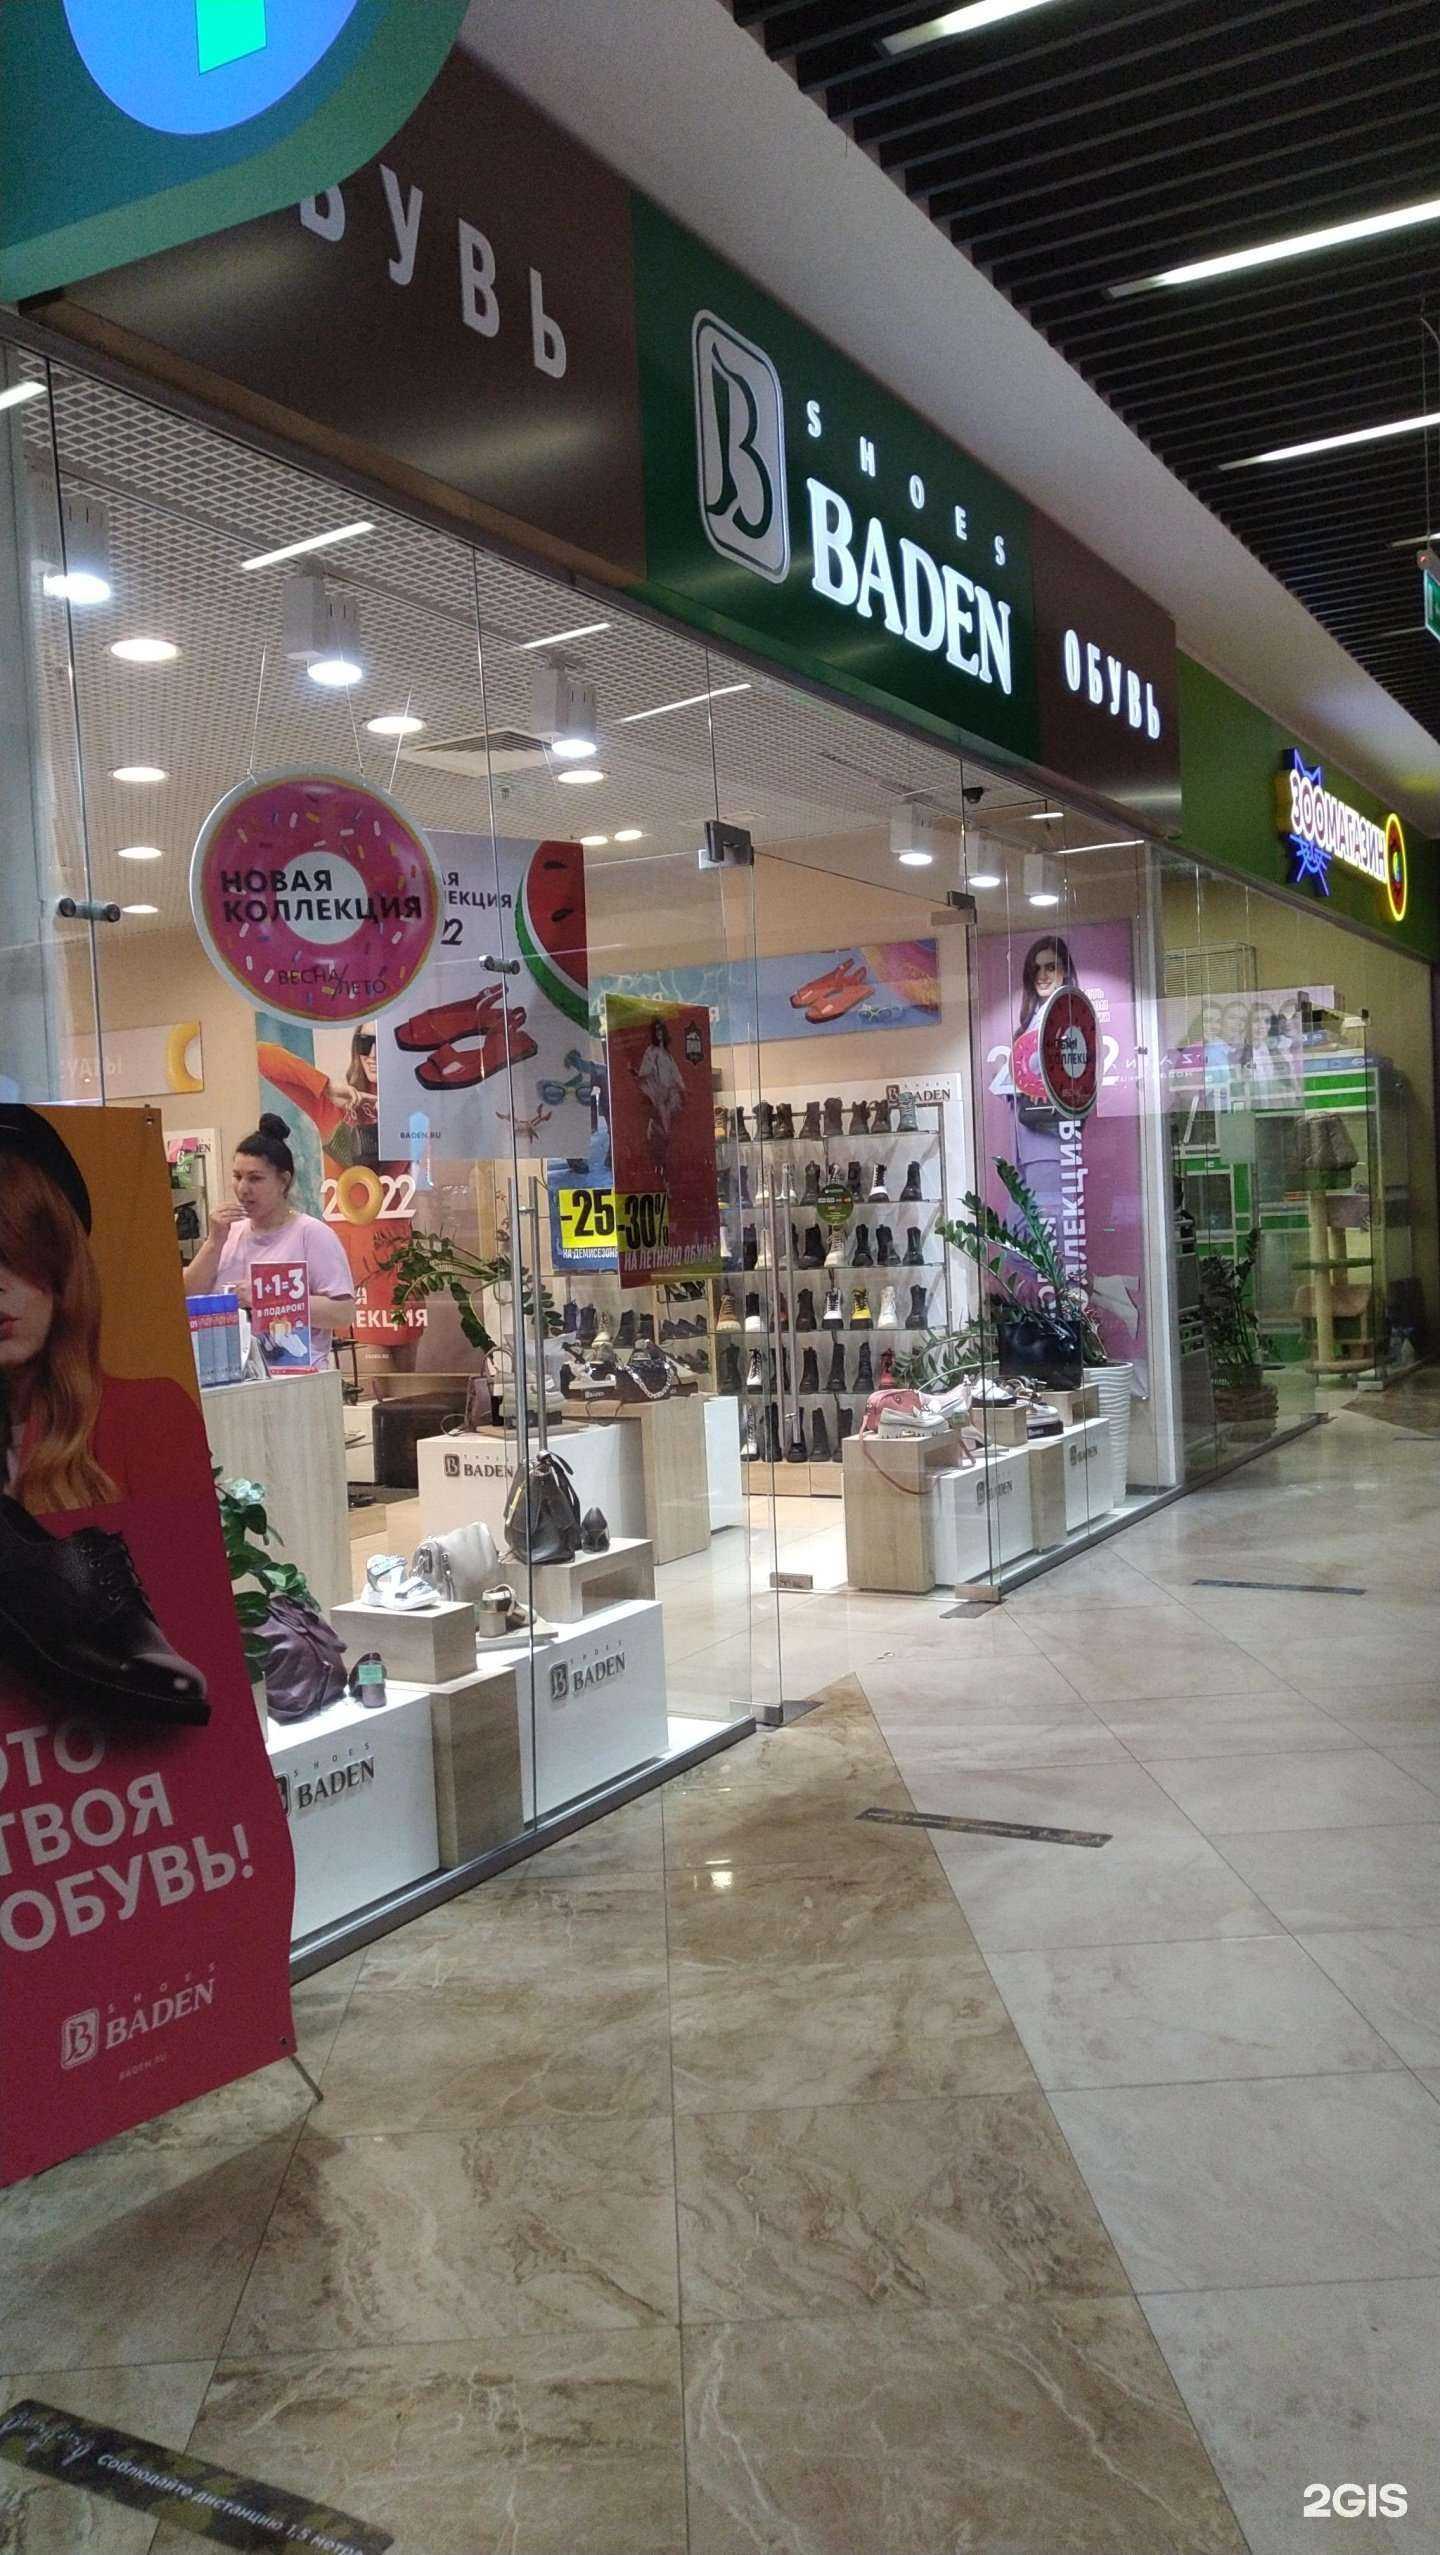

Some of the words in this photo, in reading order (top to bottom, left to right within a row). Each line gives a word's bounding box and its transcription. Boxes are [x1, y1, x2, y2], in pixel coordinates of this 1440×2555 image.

[806, 400, 1006, 567] SHOES
[806, 476, 1012, 695] BADEN
[1064, 629, 1161, 740] ОБУВЬ
[1290, 768, 1387, 884] ЗООМАГАЗИН
[220, 869, 333, 893] НОВАЯ
[444, 890, 512, 910] ЕКЦИЯ
[224, 896, 422, 924] КОЛЛЕКЦИЯ
[320, 1165, 417, 1225] 2022
[560, 1189, 615, 1237] -25
[617, 1193, 669, 1250] -30%
[254, 1268, 305, 1300] 1+1=3
[352, 1309, 429, 1332] ЕКЦИЯ
[464, 1464, 514, 1478] BADEN
[573, 1652, 626, 1692] BADEN
[298, 1756, 376, 1810] BADEN
[0, 1823, 254, 1952] ОБУВЬ!
[105, 1978, 215, 2050] BADEN
[97, 2453, 193, 2496] Соблюдайте
[192, 2490, 284, 2531] дистанцию
[285, 2524, 308, 2541] 1,5
